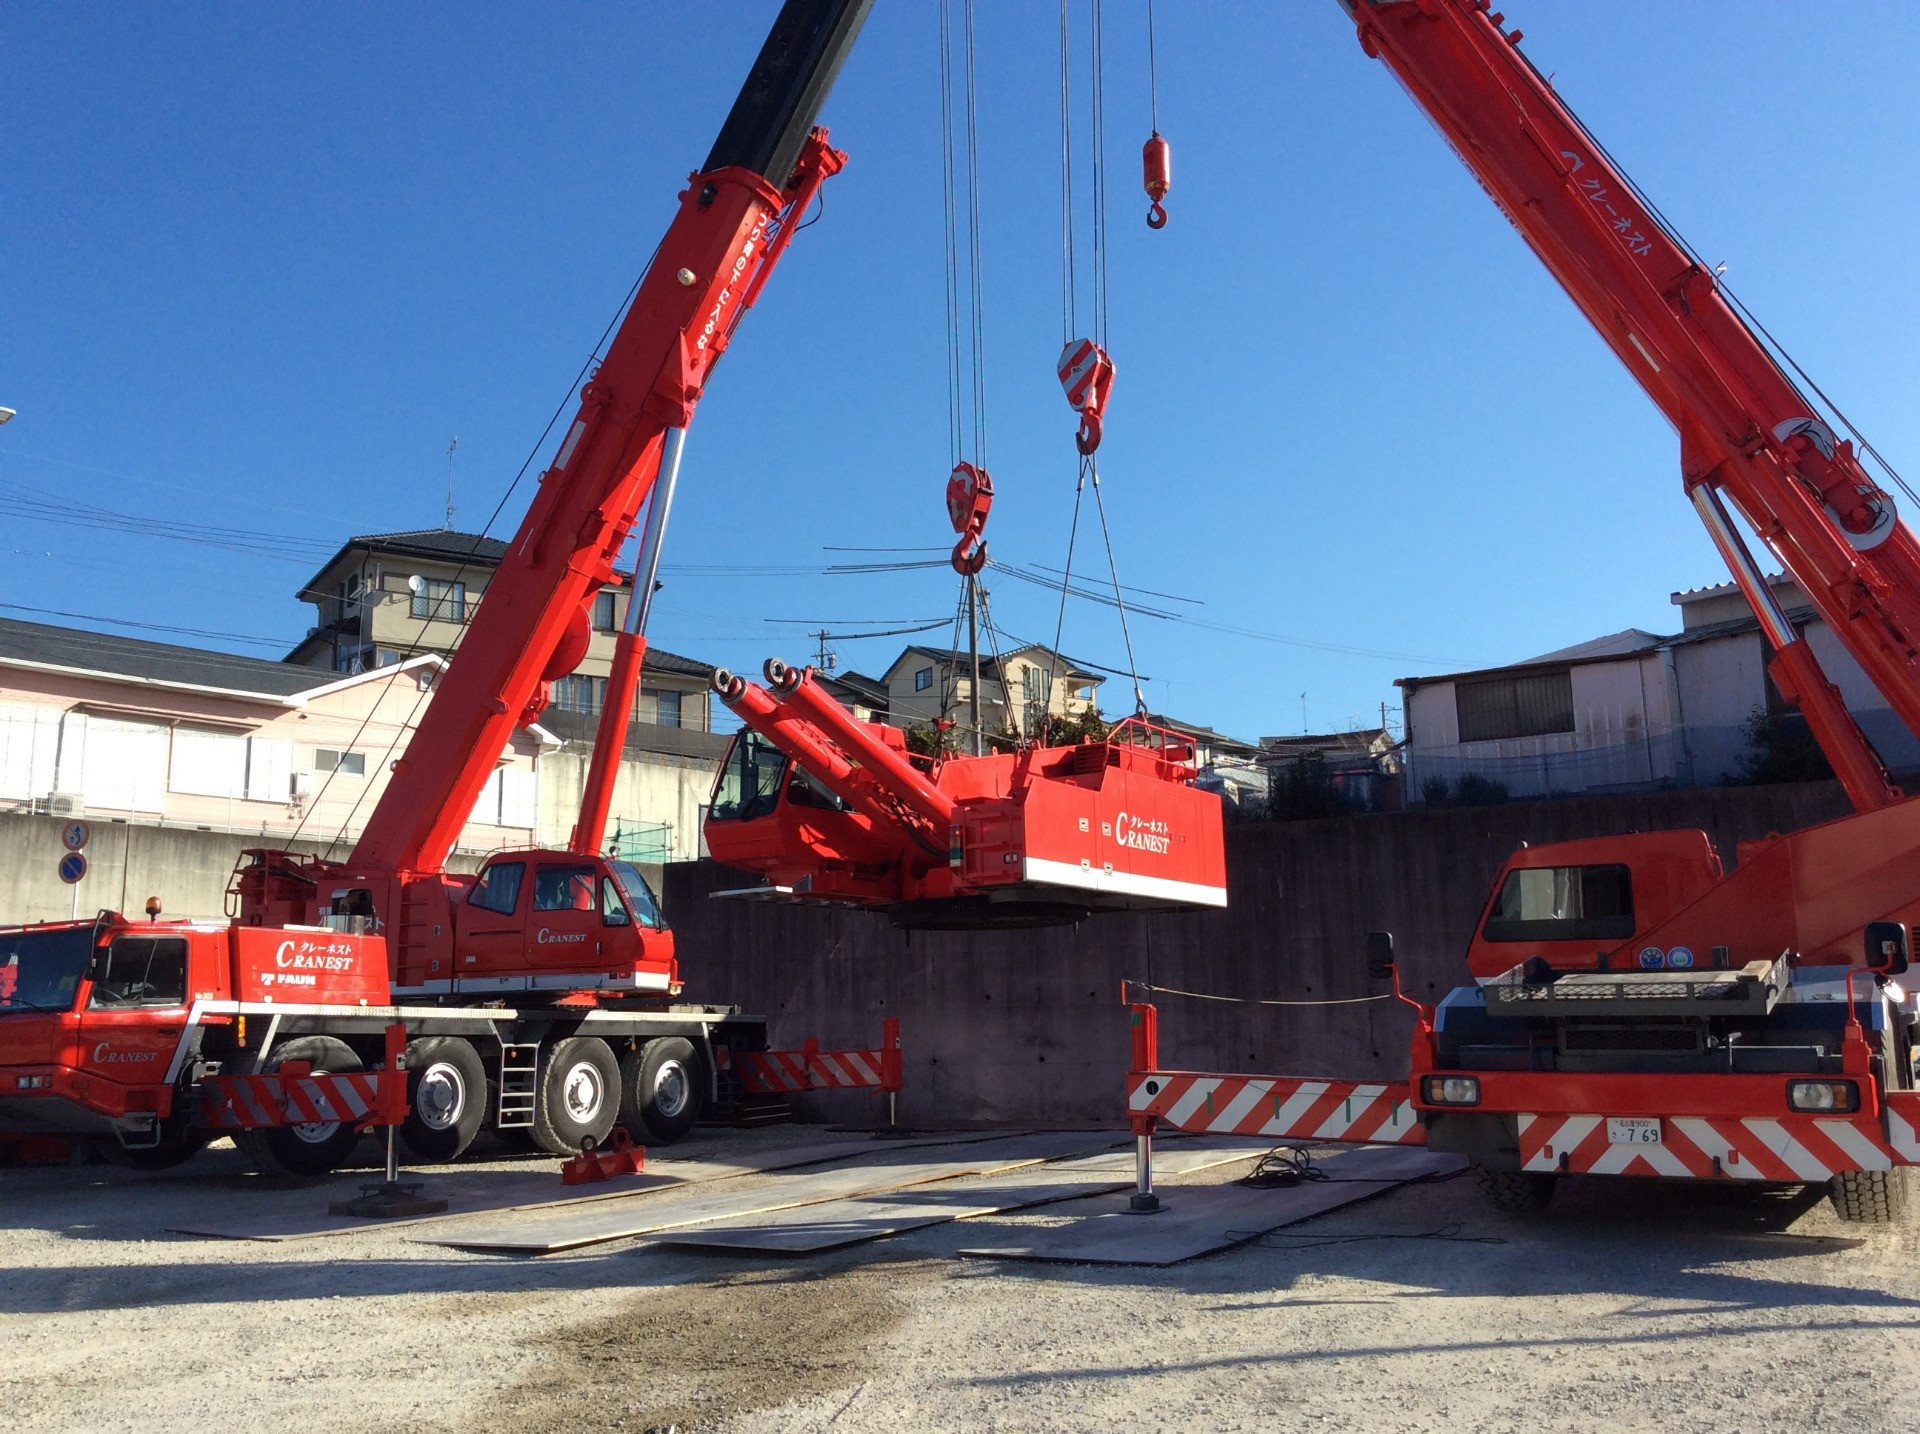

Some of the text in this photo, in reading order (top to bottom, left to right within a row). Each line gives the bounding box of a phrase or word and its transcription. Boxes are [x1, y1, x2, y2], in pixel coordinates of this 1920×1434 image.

[1579, 179, 1652, 256] クレーネスト
[1115, 811, 1170, 854] CRANEST
[1130, 815, 1168, 836] クレーネスト
[537, 927, 587, 944] CRANEST
[276, 940, 353, 970] CRANEST
[299, 941, 352, 955] クレーネスト
[93, 1042, 158, 1064] CRANEST
